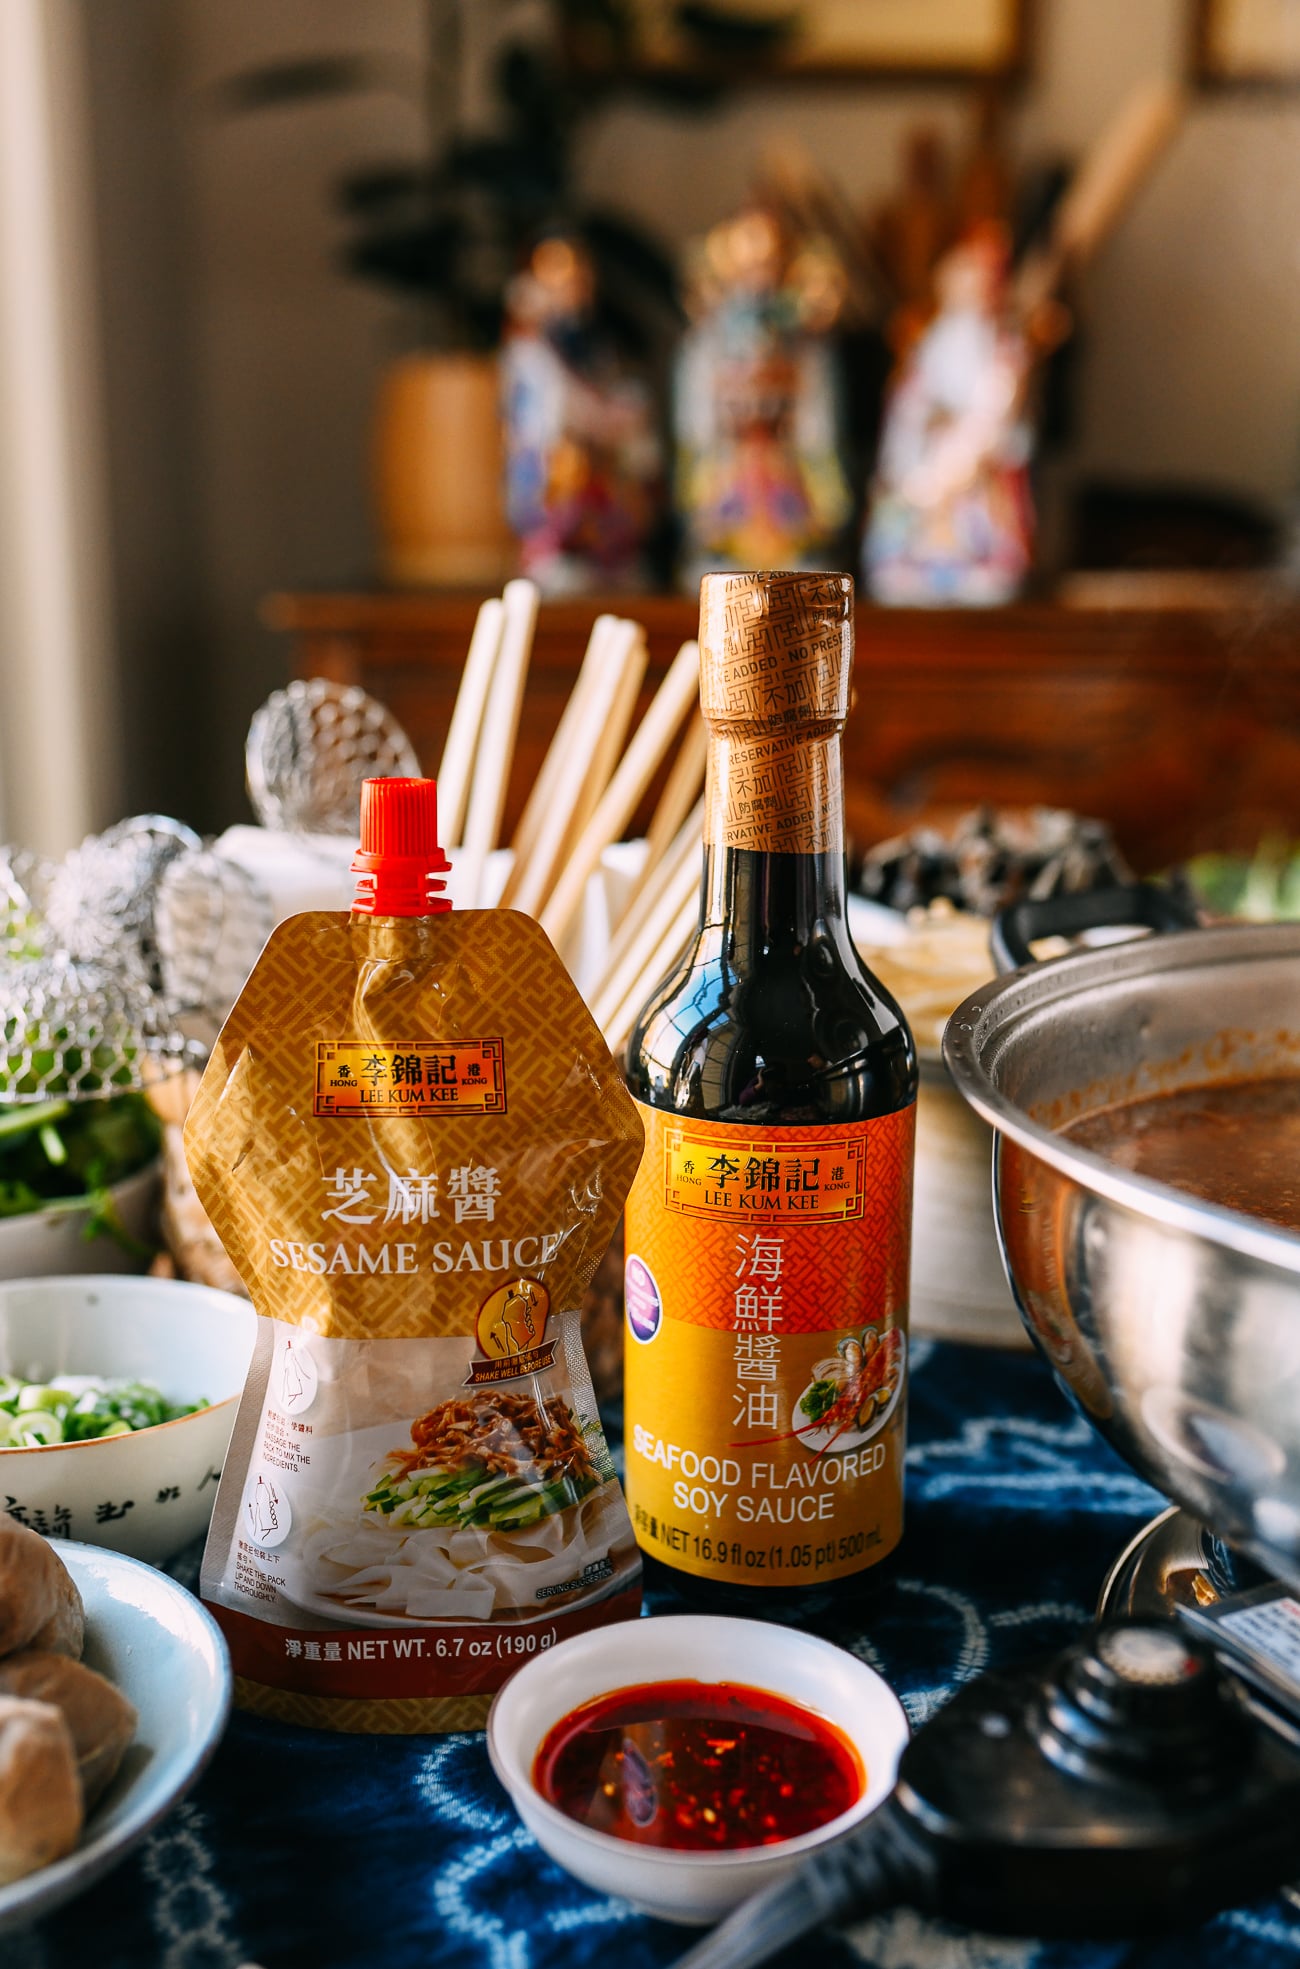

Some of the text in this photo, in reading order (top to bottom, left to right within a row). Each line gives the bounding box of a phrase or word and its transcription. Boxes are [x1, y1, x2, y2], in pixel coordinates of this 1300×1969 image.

[812, 606, 842, 624] 防腐
[733, 657, 777, 680] ADDED
[788, 648, 808, 662] NO
[811, 634, 844, 655] PRESE
[762, 681, 806, 710] 不加
[729, 735, 804, 765] RESERVATIVE
[735, 774, 773, 798] 不加
[776, 811, 815, 830] ADDED
[337, 1064, 351, 1078] 香
[360, 1054, 458, 1086] 李錦記
[467, 1063, 481, 1077] 港
[330, 1079, 357, 1087] HONG
[461, 1077, 488, 1085] KONG
[360, 1088, 458, 1103] LEE KUM KEE
[683, 1160, 695, 1174] 香
[706, 1154, 820, 1193] 李錦記
[831, 1166, 844, 1181] 港
[676, 1174, 702, 1186] HONG
[824, 1181, 850, 1192] KONG
[320, 1165, 502, 1225] 芝麻醬
[704, 1190, 819, 1210] LEE KUM KEE
[269, 1233, 560, 1275] SESAME SAUCE
[733, 1233, 784, 1430] 海鮮醬油
[475, 1370, 500, 1382] SHAKE
[501, 1366, 519, 1378] WELL
[284, 1451, 295, 1461] MIX
[296, 1454, 311, 1464] THE
[288, 1441, 301, 1453] THE
[633, 1424, 886, 1489] SEAFOOD FLAVORED
[673, 1481, 835, 1523] SOY SAUCE
[660, 1521, 690, 1555] NET
[694, 1536, 728, 1564] 16.9
[745, 1549, 766, 1568] oz
[770, 1545, 812, 1569] (1.05
[815, 1540, 837, 1569] pt)
[235, 1572, 276, 1593] UP AND DOWN
[236, 1561, 286, 1586] SHAKE THE PACK
[537, 1569, 613, 1598] SERVING SUGGESTION
[285, 1638, 342, 1661] 淨重量
[348, 1640, 388, 1660] NET
[393, 1638, 430, 1658] WT.
[435, 1638, 465, 1657] 6.7
[469, 1641, 492, 1656] oz
[495, 1633, 536, 1658] (190
